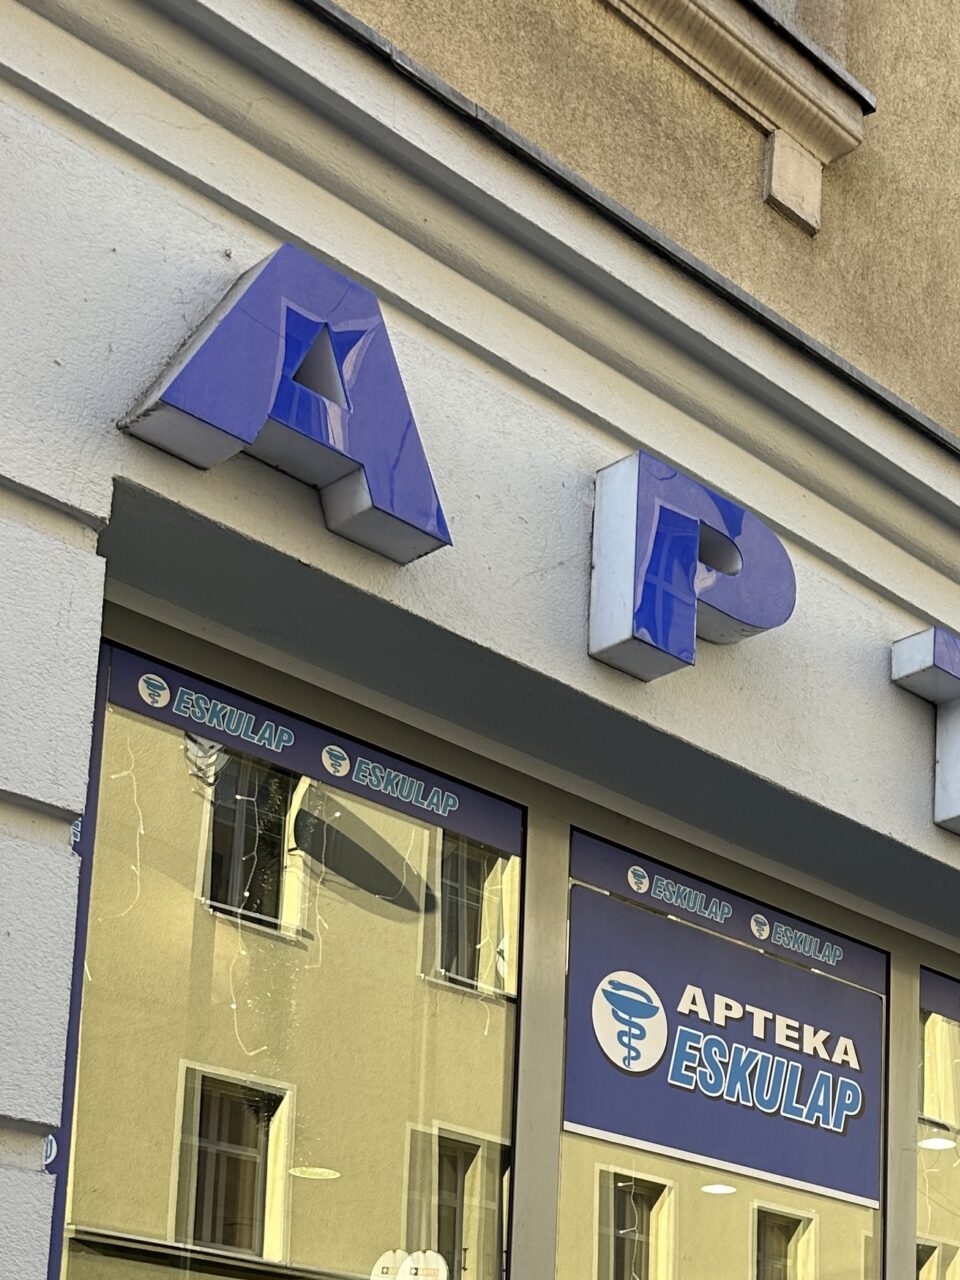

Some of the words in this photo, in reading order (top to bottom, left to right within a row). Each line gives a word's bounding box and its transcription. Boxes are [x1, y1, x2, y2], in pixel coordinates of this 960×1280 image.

[173, 688, 295, 753] ESKULAP
[352, 758, 459, 816] ESKULAP
[651, 875, 732, 925] ESKULAP
[772, 923, 844, 966] ESKULAP
[676, 984, 861, 1071] APTEKA
[668, 1027, 862, 1134] ESKULAP
